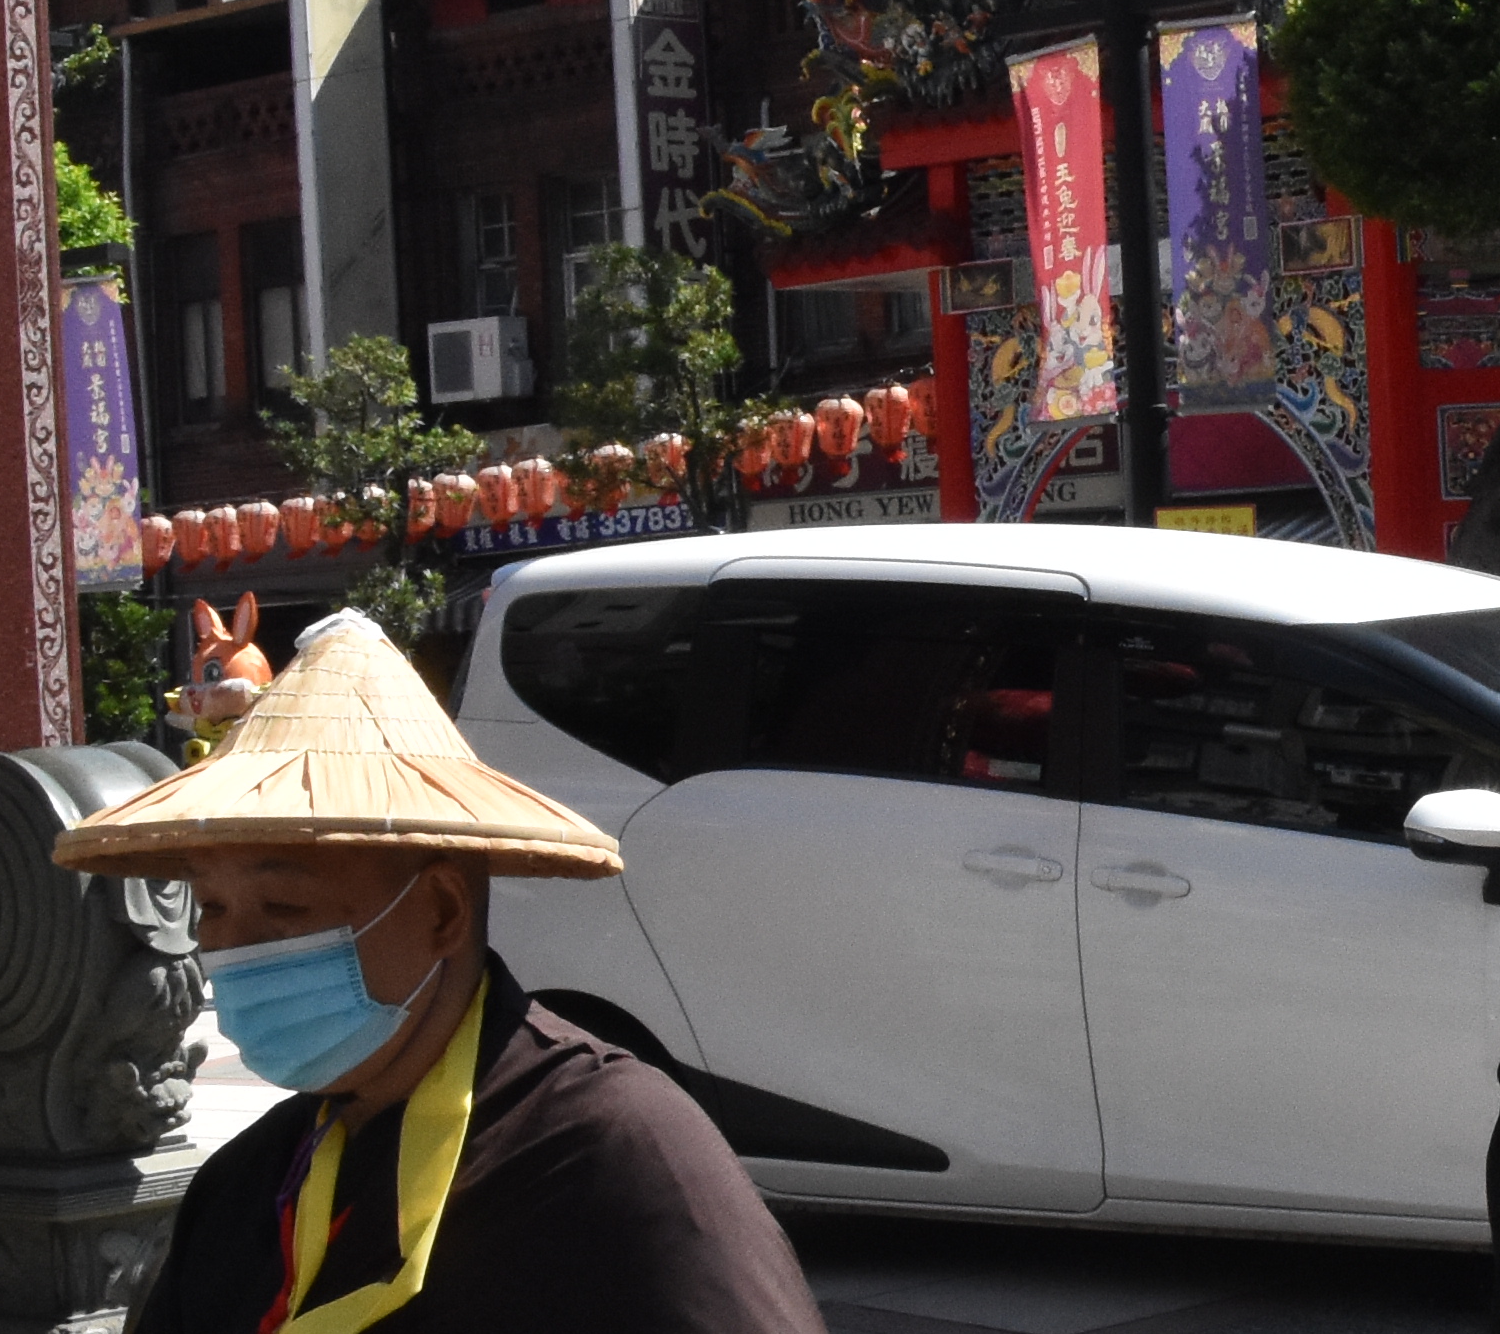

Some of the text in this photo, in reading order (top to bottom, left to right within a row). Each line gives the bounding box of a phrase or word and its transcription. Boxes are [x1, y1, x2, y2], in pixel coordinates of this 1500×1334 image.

[644, 27, 708, 259] 金時代
[1055, 162, 1082, 261] 玉兔迎春
[788, 499, 864, 525] HONG
[875, 492, 935, 517] YEW
